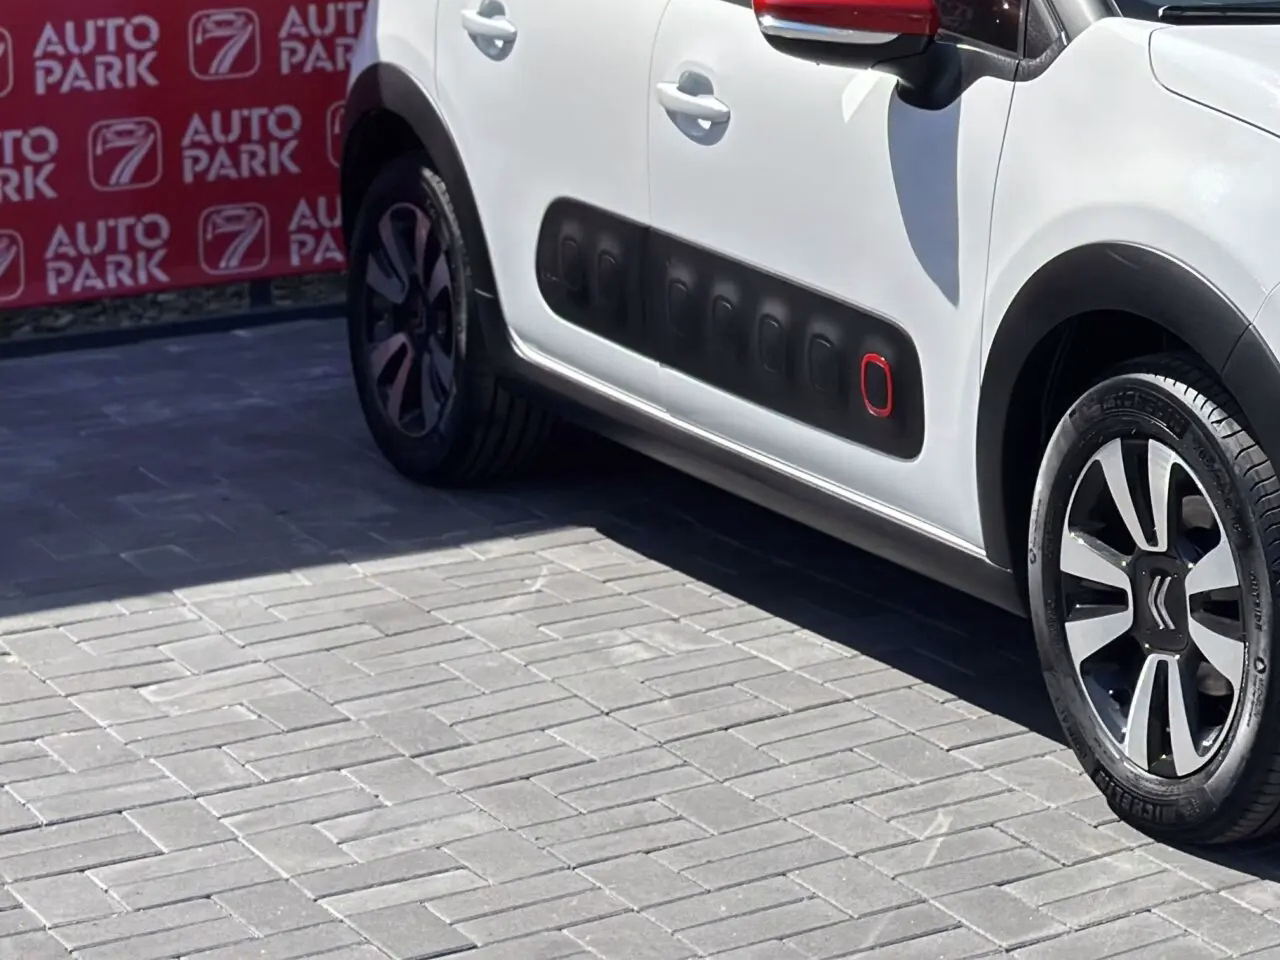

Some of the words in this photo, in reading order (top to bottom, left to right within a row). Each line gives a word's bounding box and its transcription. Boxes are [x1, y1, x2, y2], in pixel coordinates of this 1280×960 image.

[34, 15, 159, 58] AUTO
[279, 1, 366, 40] AUT
[35, 51, 158, 94] PARK
[181, 105, 301, 147] AUTO
[183, 140, 300, 183] PARK
[288, 194, 342, 232] AU
[45, 214, 169, 259] AUTO
[290, 231, 346, 267] PA
[47, 249, 169, 294] PARK
